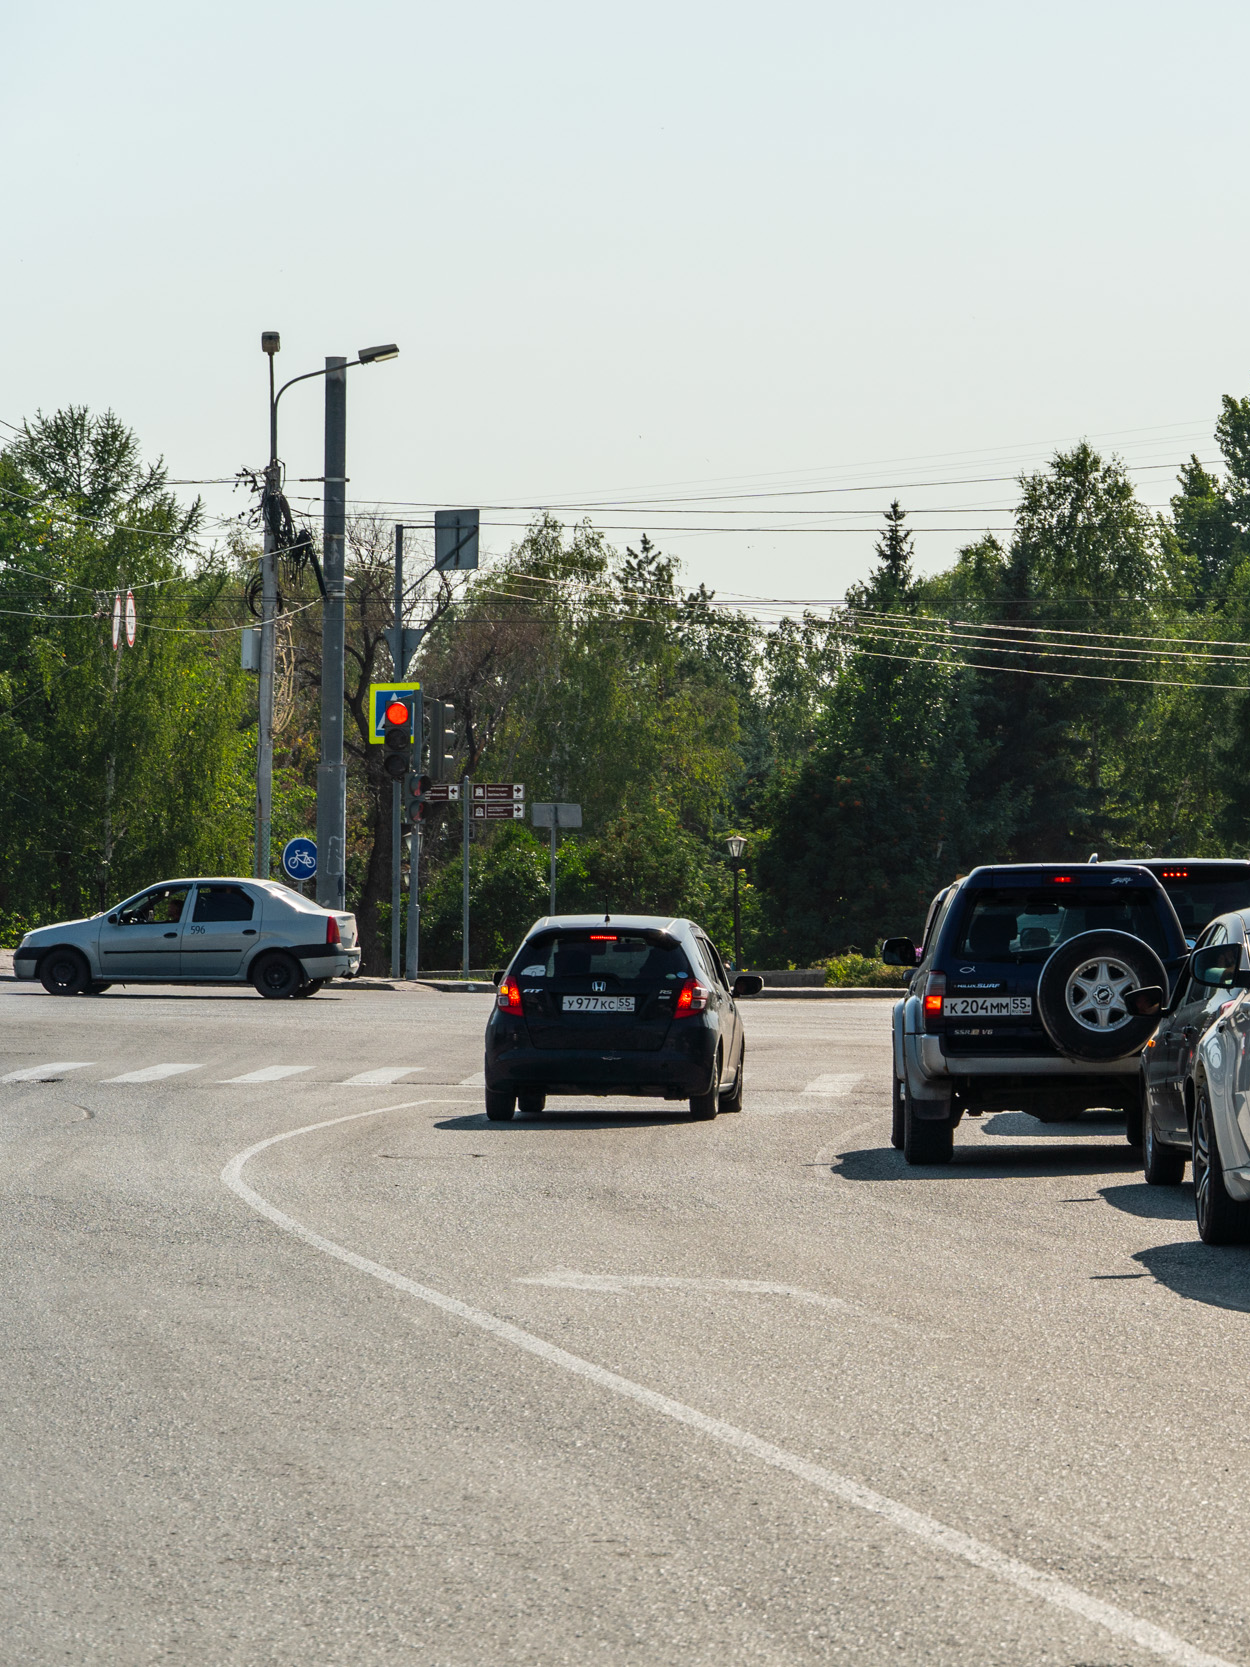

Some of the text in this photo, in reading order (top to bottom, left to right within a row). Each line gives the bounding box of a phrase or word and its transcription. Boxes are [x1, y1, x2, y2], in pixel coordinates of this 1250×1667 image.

[190, 925, 206, 935] 596
[618, 998, 631, 1007] 55
[1012, 998, 1027, 1010] 55
